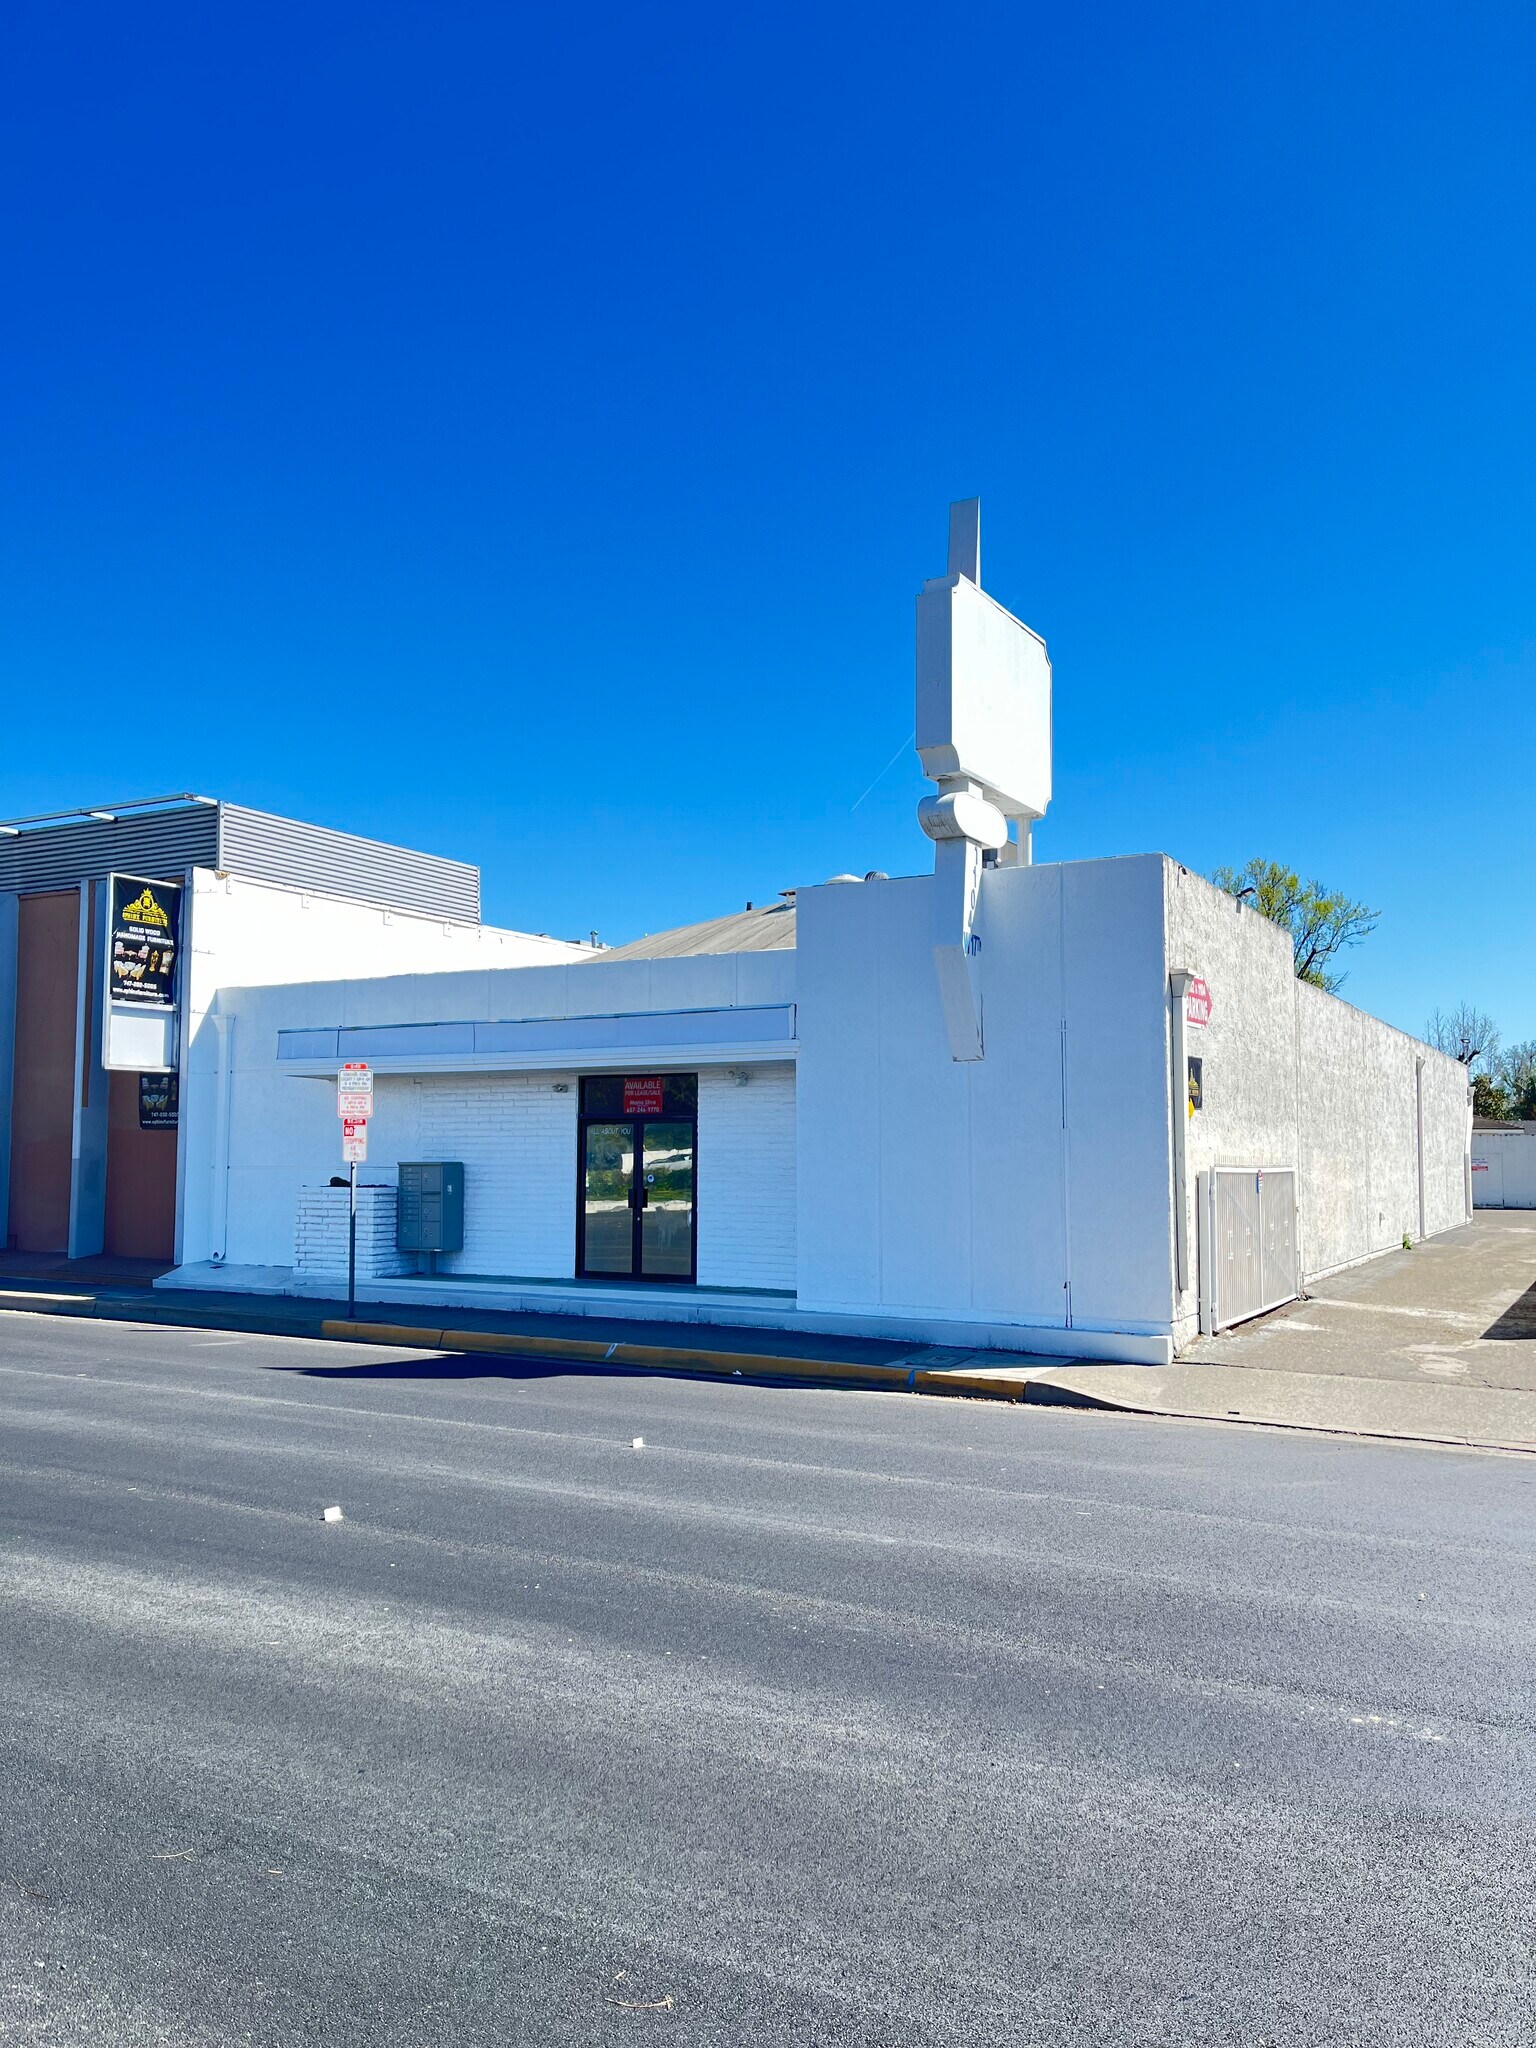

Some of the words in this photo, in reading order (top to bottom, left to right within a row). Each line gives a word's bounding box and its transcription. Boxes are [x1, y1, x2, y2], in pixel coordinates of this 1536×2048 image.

[129, 926, 144, 934] SOLID
[145, 928, 161, 936] WOOD
[116, 931, 146, 942] HANDMADE
[625, 1080, 661, 1090] AVAILABLE
[345, 1126, 353, 1135] NO
[601, 1127, 619, 1135] ABOUT
[621, 1127, 631, 1135] YOU
